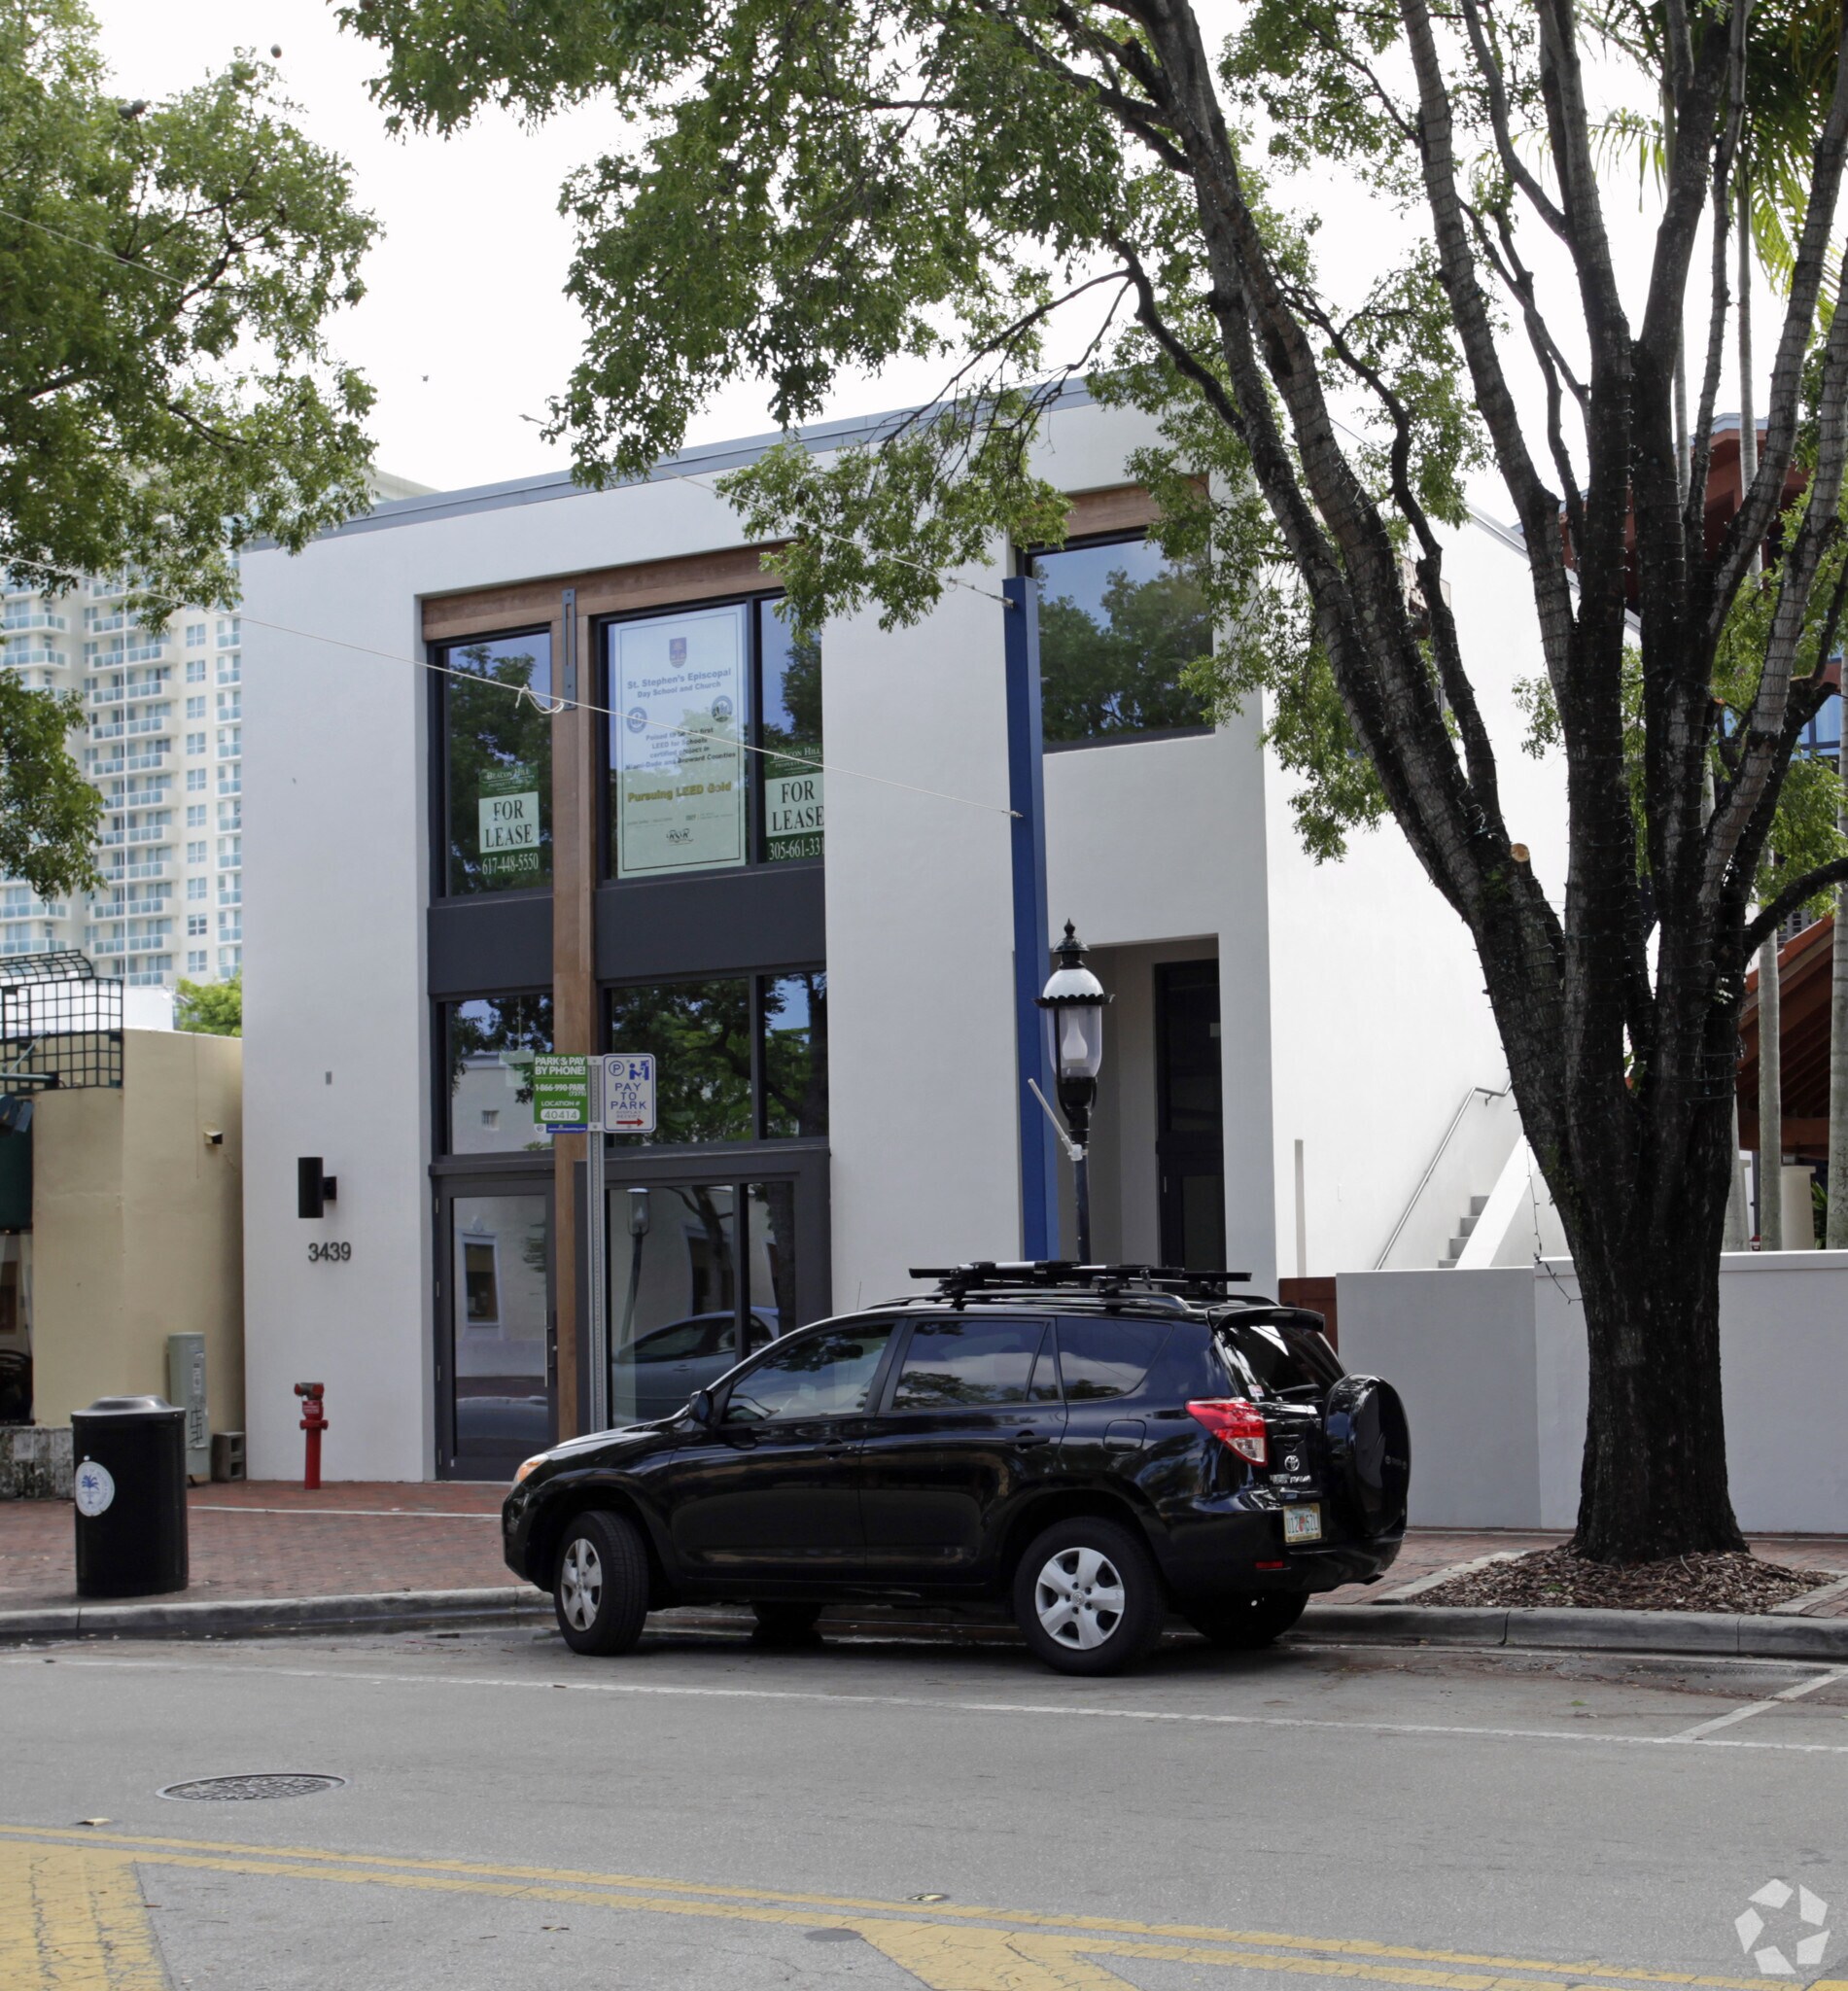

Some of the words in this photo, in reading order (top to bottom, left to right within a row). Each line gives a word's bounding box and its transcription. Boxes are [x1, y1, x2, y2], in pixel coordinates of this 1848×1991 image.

[627, 681, 640, 689] St.
[642, 675, 684, 687] Stephen's
[687, 668, 731, 681] Episcopal
[652, 686, 678, 696] School
[694, 681, 721, 690] Church
[681, 737, 708, 747] Schools
[649, 750, 678, 758] certified
[679, 748, 702, 756] project
[804, 747, 821, 755] HILL
[624, 761, 662, 770] Miami-Dade
[678, 754, 705, 764] Broward
[707, 751, 736, 760] Counties
[627, 789, 674, 803] Pursuing
[676, 784, 704, 797] LEED
[707, 782, 732, 794] Gold
[781, 780, 816, 804] FOR
[493, 799, 524, 821] FOR
[772, 805, 824, 832] LEASE
[485, 823, 534, 848] LEASE
[482, 853, 540, 875] 617-448-5550
[535, 1057, 559, 1065] PARK
[569, 1057, 585, 1065] PAY
[535, 1065, 548, 1075] BY
[549, 1065, 586, 1075] PHONE!
[536, 1083, 586, 1092] 1-866-990-PARK
[614, 1082, 642, 1091] PAY
[620, 1092, 637, 1100] TO
[610, 1100, 646, 1110] PARK
[543, 1110, 578, 1120] 40414
[307, 1241, 352, 1263] 3439
